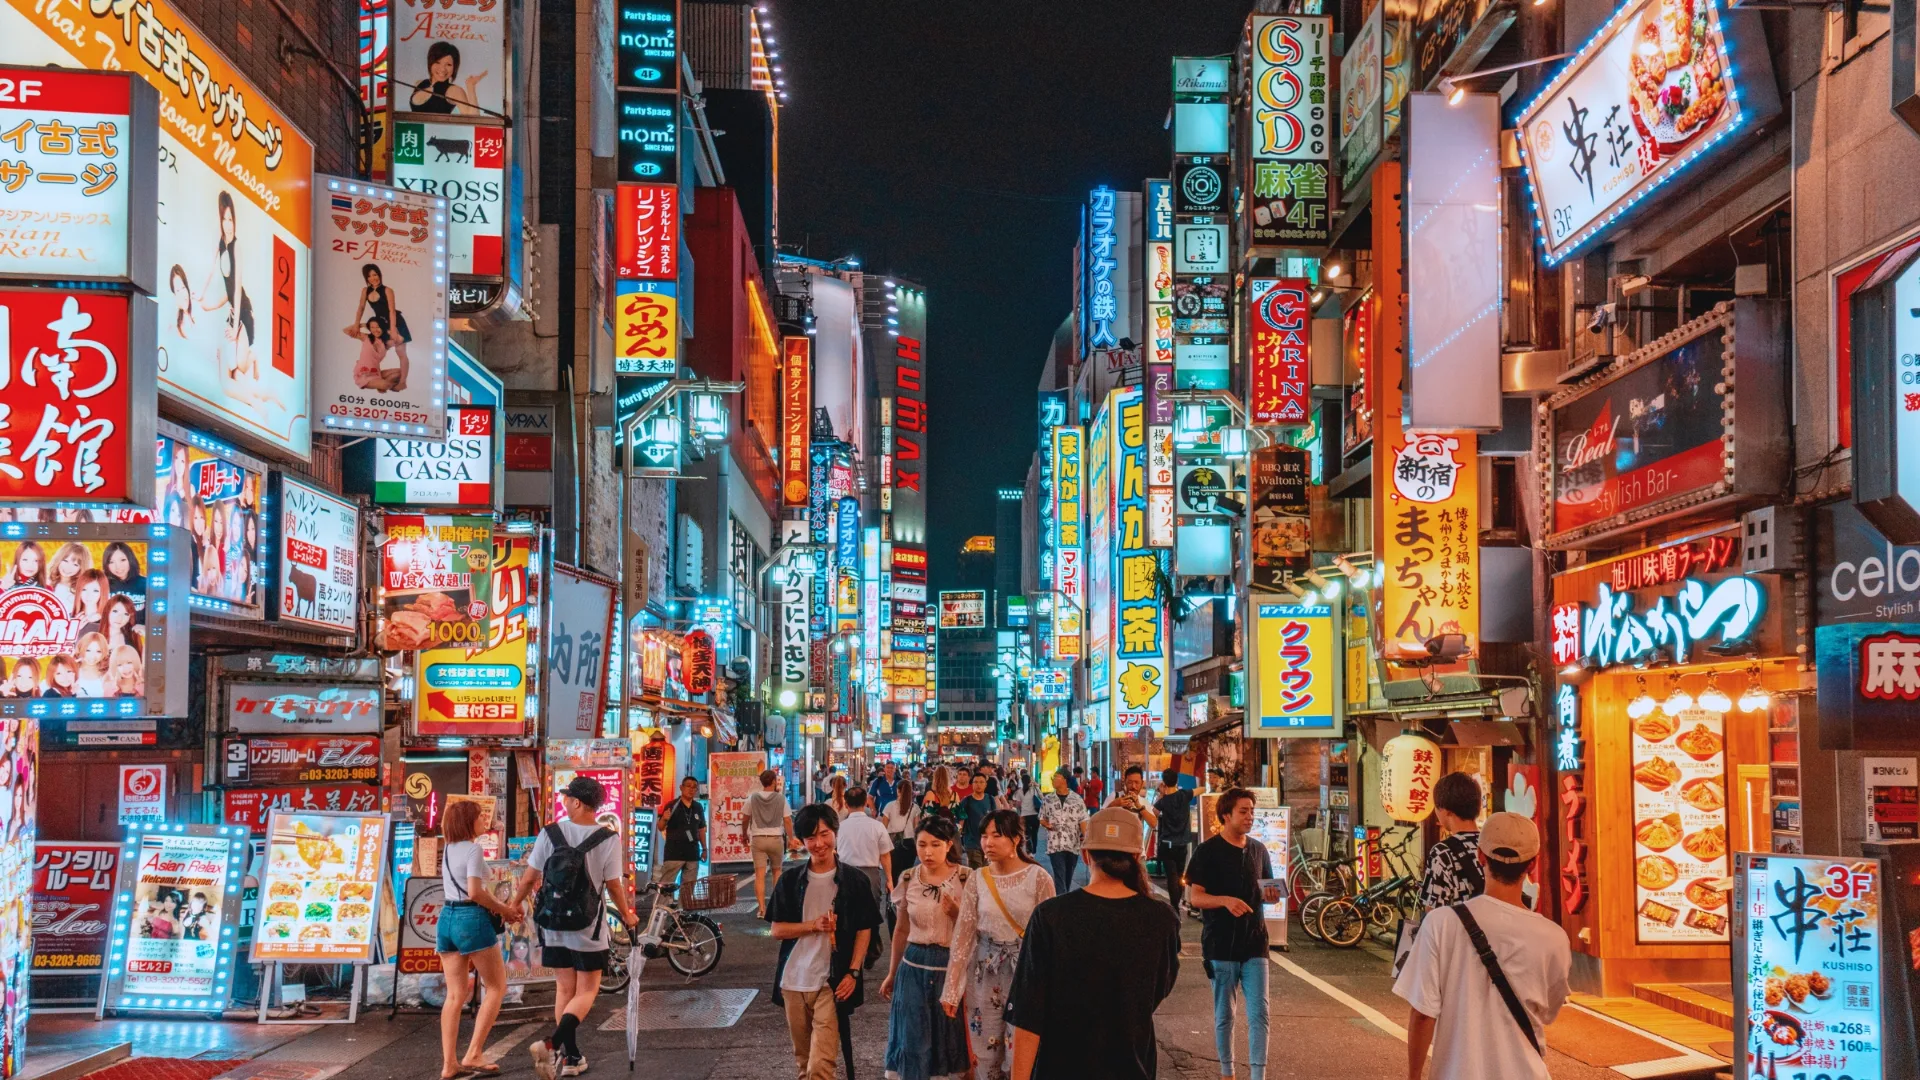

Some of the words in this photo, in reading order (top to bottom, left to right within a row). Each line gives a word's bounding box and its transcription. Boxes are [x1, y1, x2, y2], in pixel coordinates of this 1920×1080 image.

[624, 10, 645, 22] Party
[647, 11, 672, 23] Space
[435, 30, 488, 42] Relax
[641, 69, 654, 80] 4F
[1257, 17, 1306, 155] GOD
[1193, 95, 1211, 103] 7F
[624, 105, 645, 117] Party
[647, 106, 672, 118] Space
[401, 130, 418, 147] 肉
[398, 148, 422, 158] バル
[479, 148, 499, 158] アン
[661, 144, 675, 152] 2007
[1562, 97, 1635, 206] 串荘
[1193, 156, 1211, 164] 6F
[212, 131, 281, 211] Massage
[641, 164, 654, 174] 3F
[1253, 161, 1328, 200] 麻雀
[1602, 162, 1636, 196] KUSHISO
[354, 199, 429, 226] タイ古式
[660, 189, 671, 241] レンタルルーム
[1155, 184, 1173, 239] JAビル
[1193, 216, 1211, 224] 5F
[1286, 201, 1326, 229] 4F
[331, 214, 429, 245] マッサージ
[1553, 205, 1574, 239] 3F
[637, 188, 655, 278] リフレッシュ
[332, 239, 359, 254] 2F
[660, 245, 671, 274] ホステル
[1090, 184, 1118, 348] カラオケの鉄人
[620, 267, 632, 275] 2F
[637, 282, 659, 293] 1F
[1193, 277, 1212, 285] 4F
[1253, 281, 1271, 292] 3F
[624, 296, 669, 357] らーめん
[1194, 337, 1212, 345] 3F
[1259, 289, 1305, 414] CARINA
[618, 358, 675, 372] 博多天神
[1257, 331, 1266, 411] 個室ダイニング
[1266, 331, 1283, 412] カリーナ
[339, 394, 365, 405] 60分
[618, 391, 642, 409] Party
[330, 404, 428, 424] 03-3207-5527
[790, 355, 802, 471] 個室ダイニング居酒屋
[464, 423, 486, 434] アン
[383, 439, 482, 459] XROSS
[1562, 415, 1621, 473] Real
[395, 460, 473, 481] CASA
[1261, 463, 1281, 473] BBQ
[1283, 462, 1300, 473] 東京
[1397, 455, 1453, 488] 新宿
[199, 463, 241, 500] 即デート
[1159, 472, 1170, 481] 1F
[1260, 474, 1303, 486] Walton's
[1060, 435, 1078, 546] まんが喫茶
[1268, 492, 1294, 500] 新宿本店
[1416, 485, 1436, 500] の
[286, 489, 331, 516] ヘルシー
[285, 510, 319, 541] 肉バル
[841, 501, 856, 556] カラオケ
[1195, 518, 1213, 526] B1
[388, 525, 489, 542] 肉祭り開催中
[1454, 507, 1471, 565] 博多もつ鍋
[840, 557, 854, 565] 747
[1437, 508, 1455, 608] 九州のうまかもん
[1611, 536, 1734, 593] 旭川味噌ラーメン
[1272, 569, 1294, 584] 2F
[1395, 506, 1437, 644] まっちゃん
[319, 583, 353, 606] 高タンパク
[1456, 568, 1472, 610] 水炊き
[318, 602, 353, 624] 低カロリー
[784, 529, 806, 684] とんかつにいむら
[1260, 605, 1330, 616] オンラインカフェ
[1875, 603, 1914, 618] Stylish
[1280, 619, 1313, 713] クラウン
[1034, 674, 1055, 684] 完全
[1044, 684, 1065, 694] 個室
[453, 704, 515, 719] 受付3F
[1117, 712, 1163, 727] マンボー
[1289, 717, 1305, 726] B1
[1557, 683, 1579, 772] 角煮
[227, 743, 248, 778] 3F
[251, 749, 316, 765] レンタルルーム
[318, 740, 380, 767] Eden
[309, 768, 377, 781] 03-3203-9666
[1406, 748, 1434, 815] 鉄なべ餃子
[124, 807, 159, 815] すてるな
[231, 810, 252, 822] 4F
[142, 852, 185, 873] Asian
[187, 860, 225, 874] Relax
[46, 869, 111, 890] ルーム
[141, 875, 177, 884] Welcome
[1825, 866, 1871, 899] 3F
[1751, 874, 1766, 917] 三十年
[1769, 866, 1872, 966] 串荘
[34, 954, 102, 967] 03-3203-9666
[129, 961, 171, 972] 当ビル2F
[1822, 961, 1873, 972] KUSHISO
[1846, 984, 1870, 996] 個室
[1846, 996, 1870, 1008] 完備
[1838, 1022, 1871, 1035] 268円
[1803, 1038, 1836, 1050] 串焼き
[1803, 1054, 1848, 1070] 串揚げ
